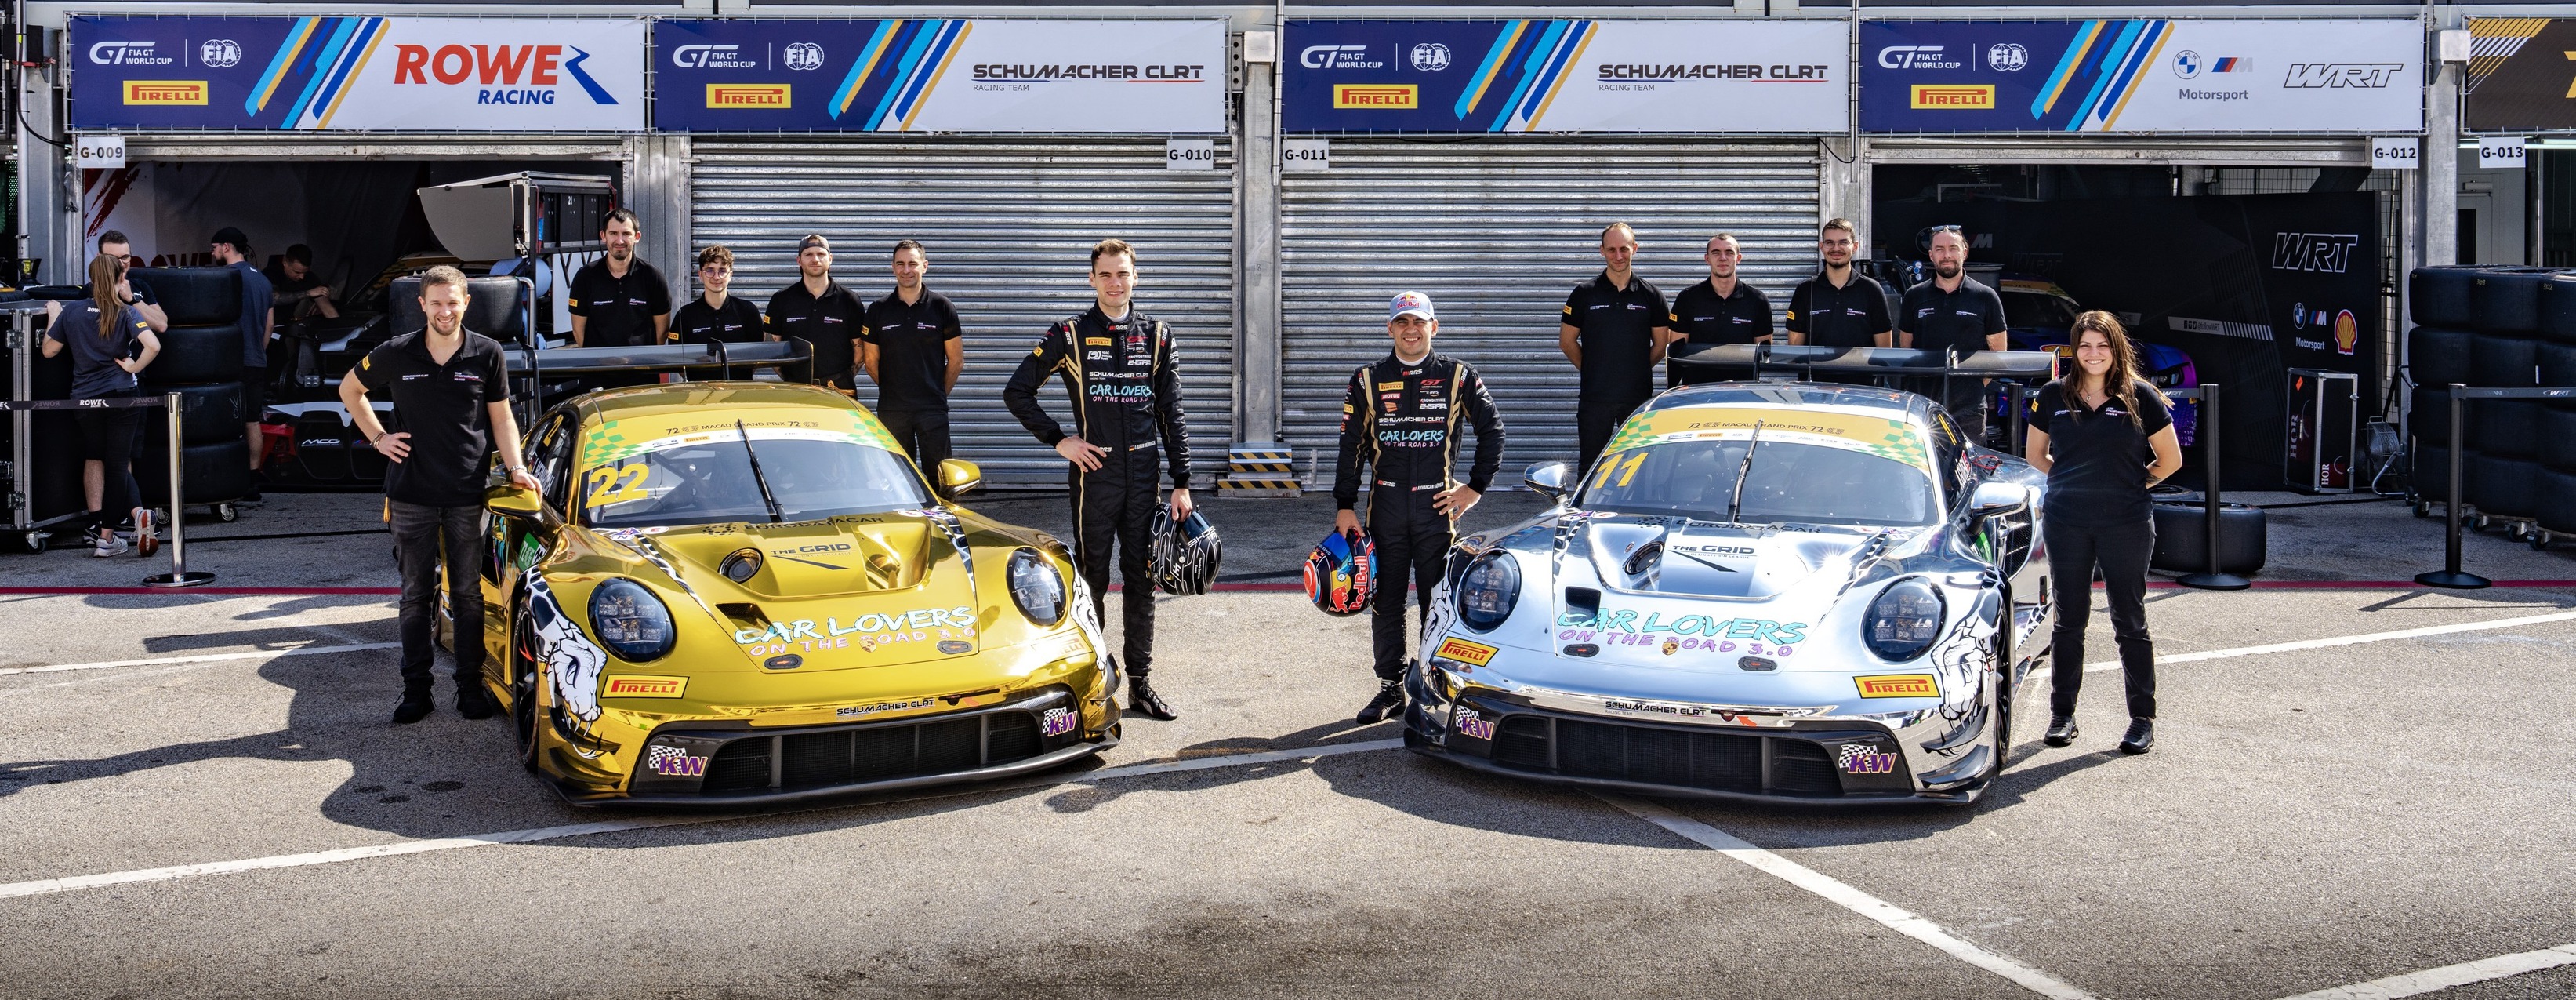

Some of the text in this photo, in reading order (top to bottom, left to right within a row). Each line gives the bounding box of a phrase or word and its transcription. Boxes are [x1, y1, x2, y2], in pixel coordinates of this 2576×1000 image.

[394, 45, 562, 85] ROWE
[973, 65, 1203, 79] SCHUMACHER CLRT
[1599, 65, 1830, 79] SCHUMACHER CLRT
[2284, 64, 2404, 88] WRT
[132, 85, 201, 100] PIRELLI
[477, 89, 555, 105] RACING
[715, 89, 784, 104] PIRELLI
[1343, 89, 1412, 104] PIRELLI
[1918, 89, 1987, 104] PIRELLI
[2179, 89, 2248, 101] Motorsport
[80, 147, 123, 159] G-009
[1169, 149, 1212, 161] G-010
[1284, 149, 1327, 161] G-011
[2374, 147, 2415, 159] G-012
[2481, 147, 2523, 159] G-013
[2273, 232, 2358, 273] WRT
[2295, 337, 2325, 351] Motorsport
[1089, 384, 1152, 397] CAR LOVERS
[1380, 430, 1444, 442] CAR LOVERS
[1594, 453, 1649, 489] 11
[586, 464, 650, 508] 22
[799, 544, 851, 553] GRID
[1701, 545, 1755, 554] GRID
[1348, 555, 1368, 610] Red Bull
[735, 606, 977, 645] CAR LOVERS
[1557, 607, 1808, 645] CAR LOVERS
[749, 643, 786, 656] ON
[800, 637, 849, 653] THE
[936, 627, 975, 638] 3.0
[1559, 630, 1596, 642] ON
[1607, 631, 1656, 645] THE
[1748, 643, 1793, 657] 3.0
[1442, 641, 1497, 663] PIRELLI
[611, 679, 679, 693] PIRELLI
[1863, 678, 1931, 695] PIRELLI
[836, 699, 935, 715] SCHUMACHER CLRT
[1605, 701, 1677, 714] SCHUMACHER
[1047, 710, 1079, 736] KW
[1459, 715, 1495, 740] KW
[658, 755, 709, 777] KW
[1848, 751, 1898, 774] KW
